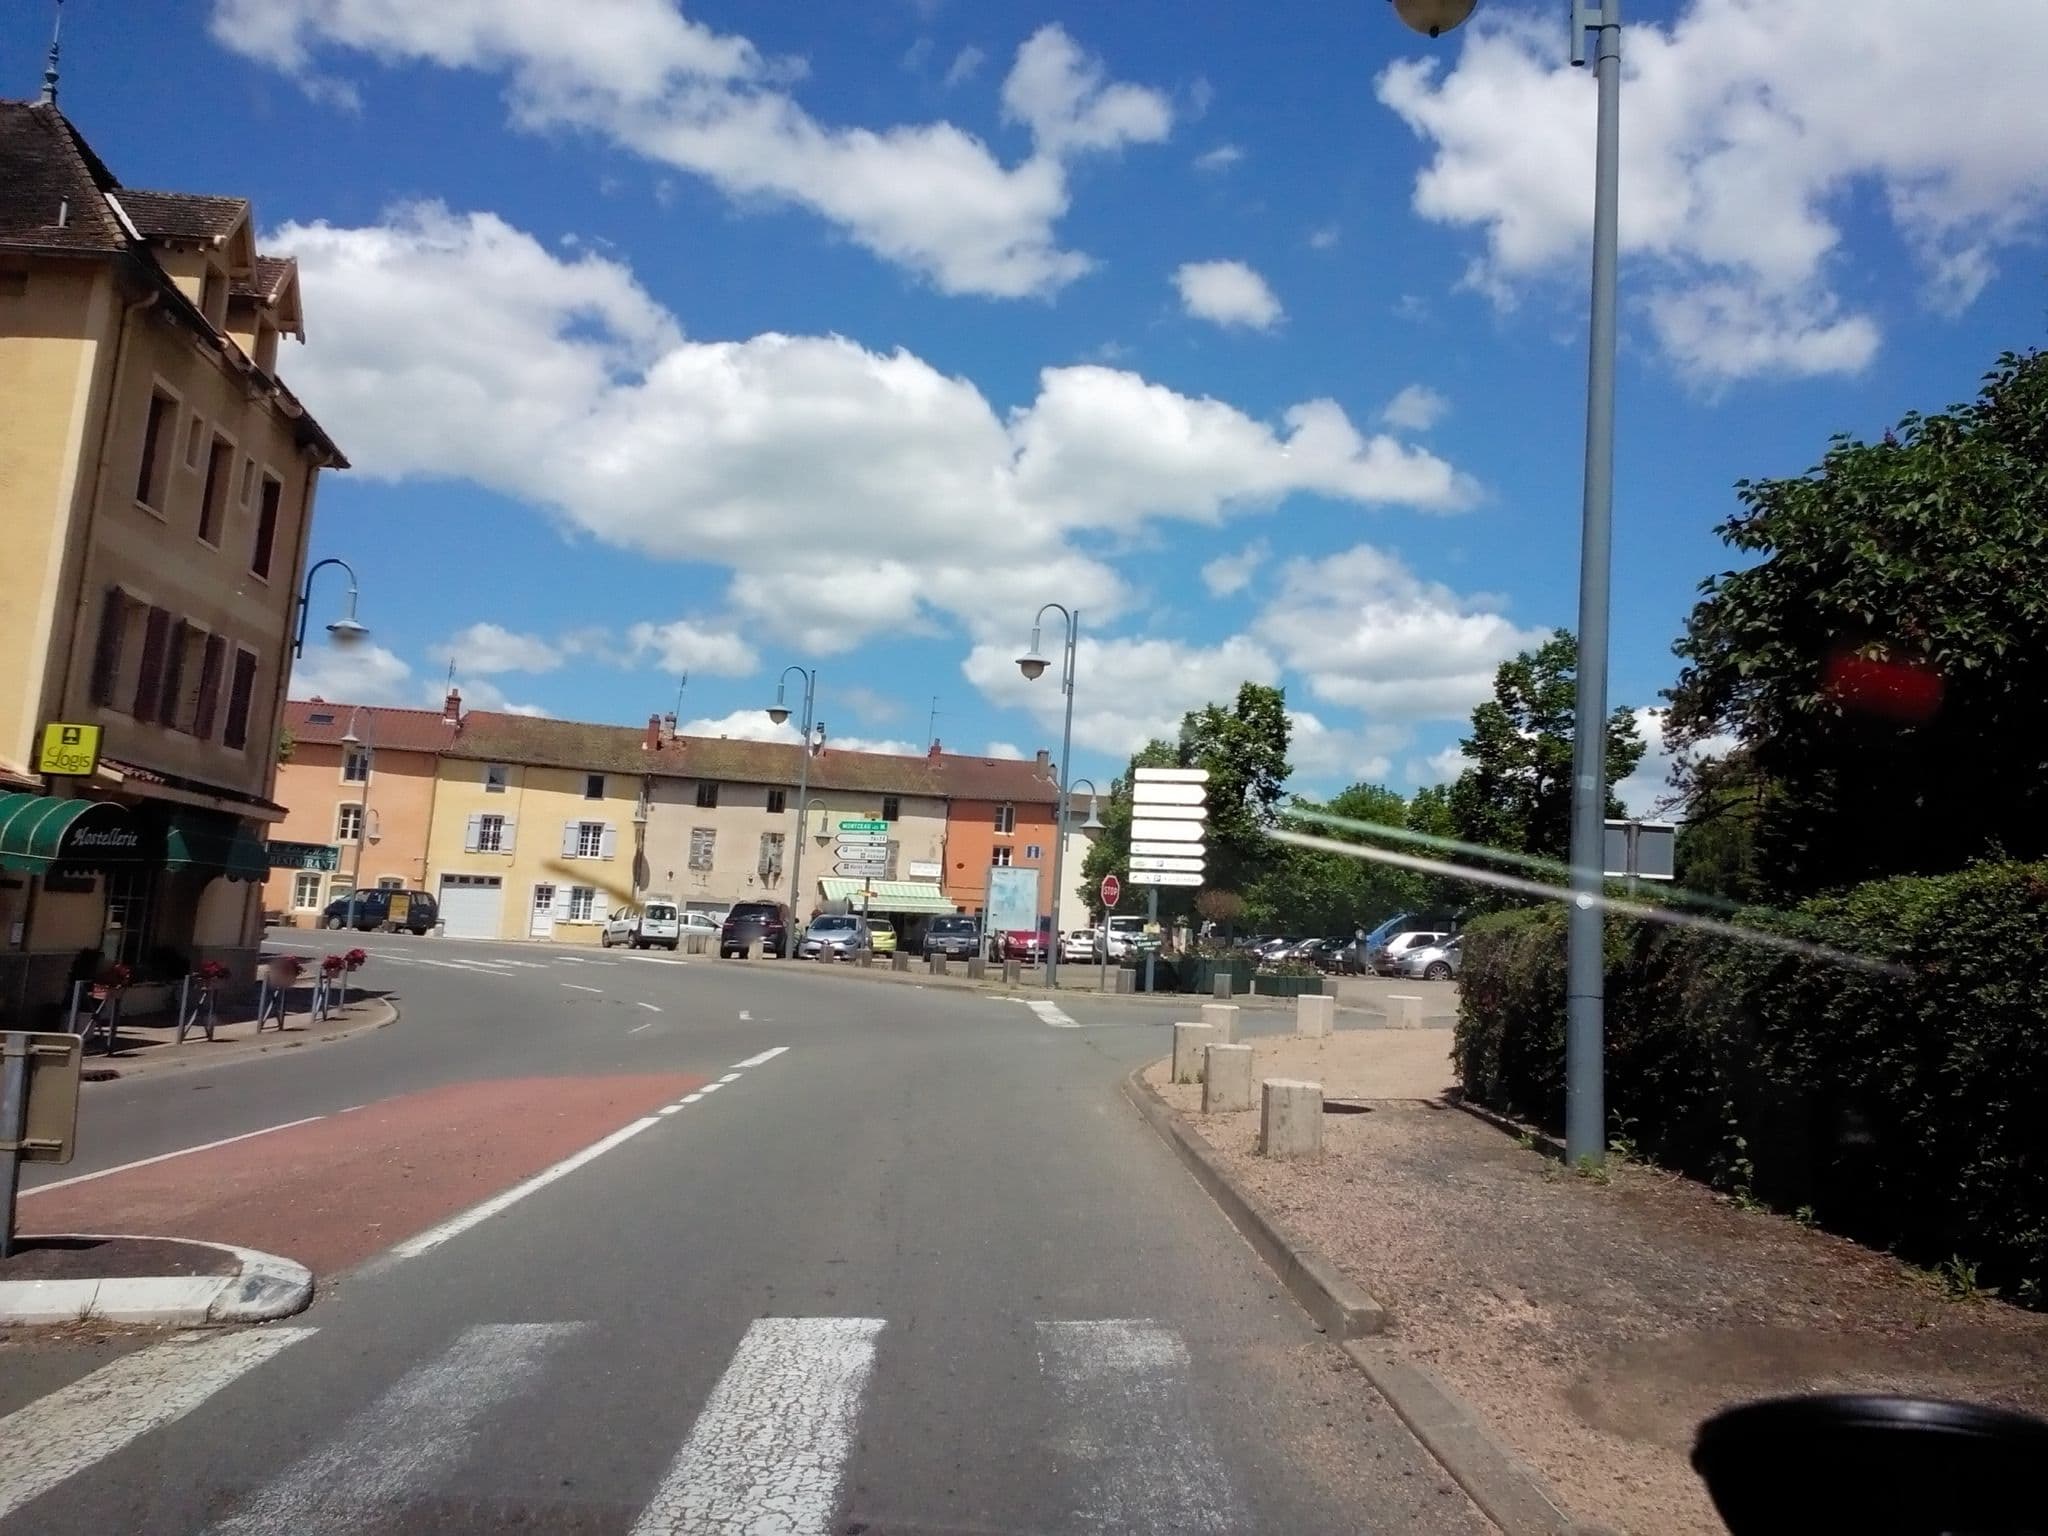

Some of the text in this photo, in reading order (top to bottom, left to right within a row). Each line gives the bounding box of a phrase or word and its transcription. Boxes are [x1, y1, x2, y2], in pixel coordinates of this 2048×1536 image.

[43, 745, 91, 772] Logis
[70, 826, 138, 847] Hostellerie
[269, 855, 336, 870] RESTAURANT
[1103, 886, 1118, 896] STOP
